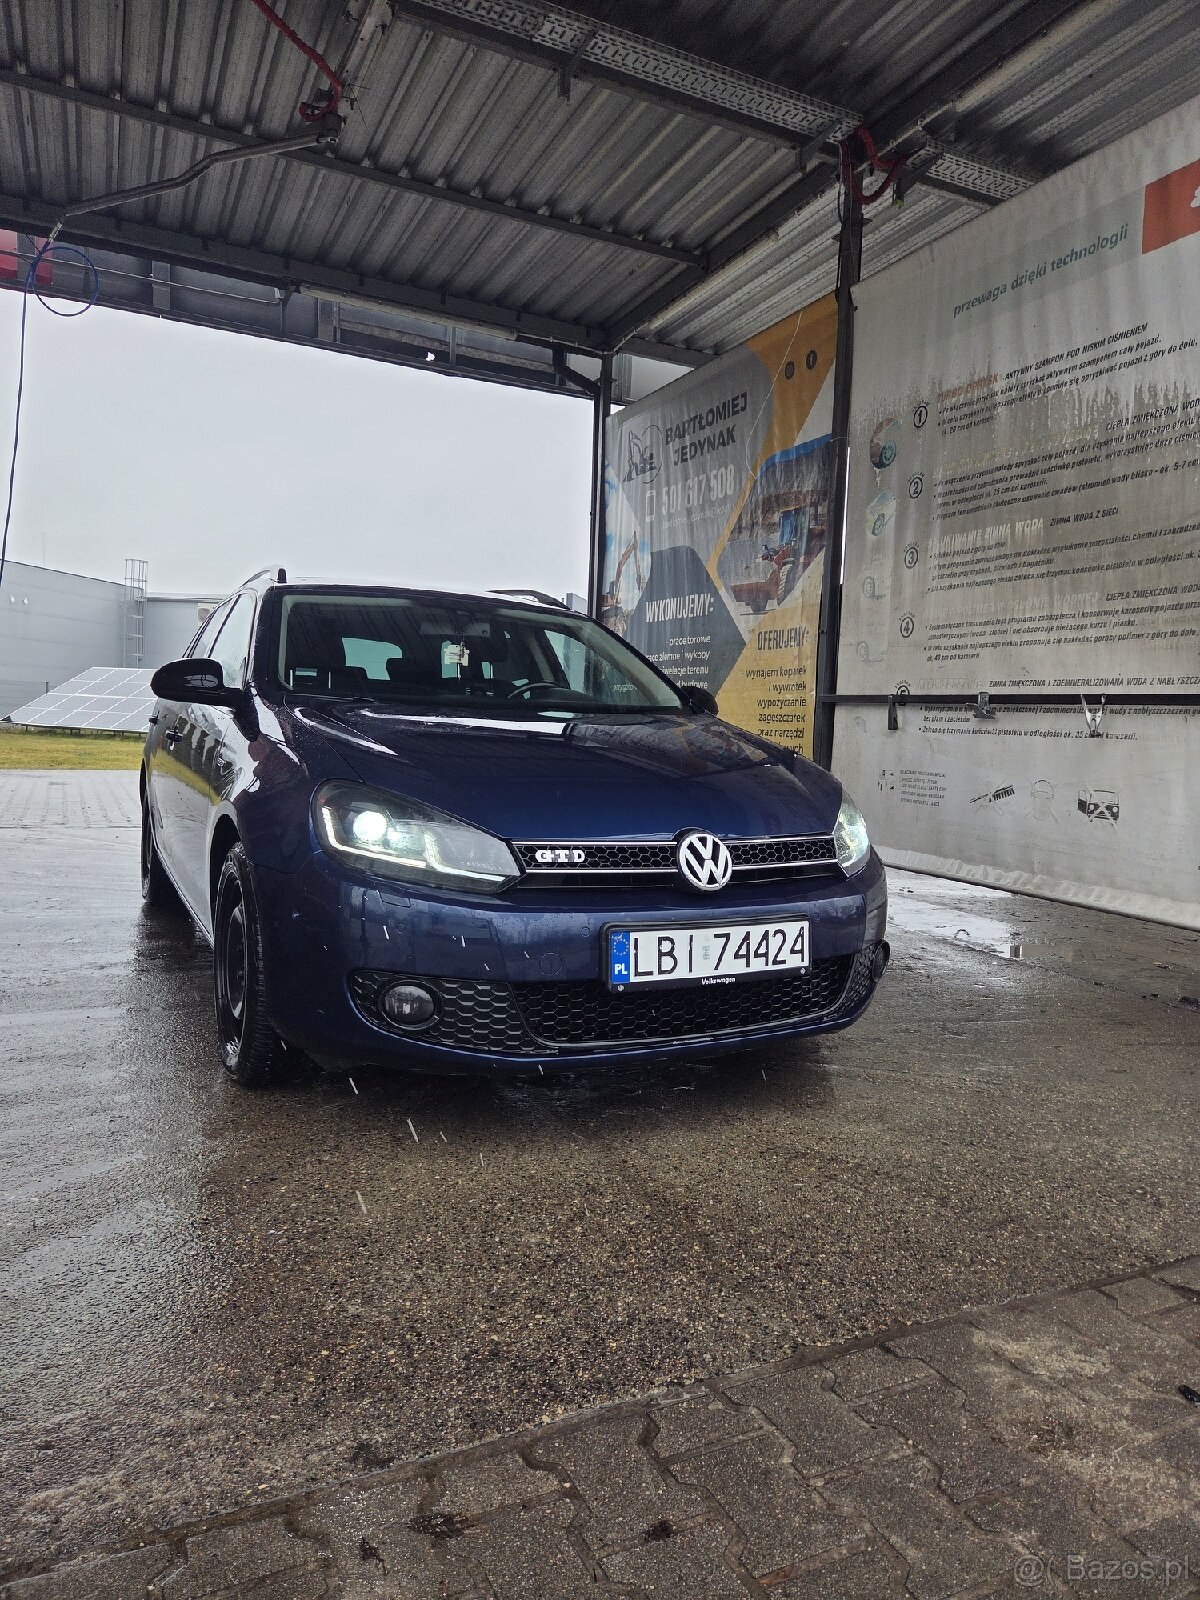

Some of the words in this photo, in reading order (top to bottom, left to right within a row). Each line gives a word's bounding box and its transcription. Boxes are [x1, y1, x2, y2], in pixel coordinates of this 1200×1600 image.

[954, 283, 1007, 318] przewaga
[1011, 262, 1047, 290] dzięki
[1051, 224, 1128, 271] technologii
[1034, 354, 1064, 370] SZAMPON
[665, 391, 747, 445] BARTŁOMIEJ
[674, 424, 736, 466] JEDYNAK
[662, 481, 682, 515] 501
[685, 473, 706, 508] 617
[710, 464, 735, 501] 508
[1073, 512, 1093, 522] WODA
[1101, 507, 1119, 517] SIECI
[908, 548, 915, 564] 3
[1105, 592, 1130, 601] CIEPŁA
[1131, 586, 1178, 598] ZMIĘKCZONA
[1181, 584, 1200, 593] WOD
[645, 593, 714, 622] WYKONUJEMY:
[904, 620, 910, 634] 4
[669, 637, 686, 646] prace
[685, 649, 710, 662] wykopy
[661, 666, 687, 677] iwelacje
[687, 666, 709, 675] terenu
[746, 666, 779, 680] wynajem
[773, 681, 807, 694] wywrotek
[757, 696, 807, 709] wypożyczanie
[1109, 708, 1126, 716] wody
[1132, 707, 1191, 718] nabłyszczaczem
[535, 849, 586, 863] GTD
[633, 934, 693, 977] LBI
[714, 926, 805, 971] 74424
[615, 964, 627, 975] PL
